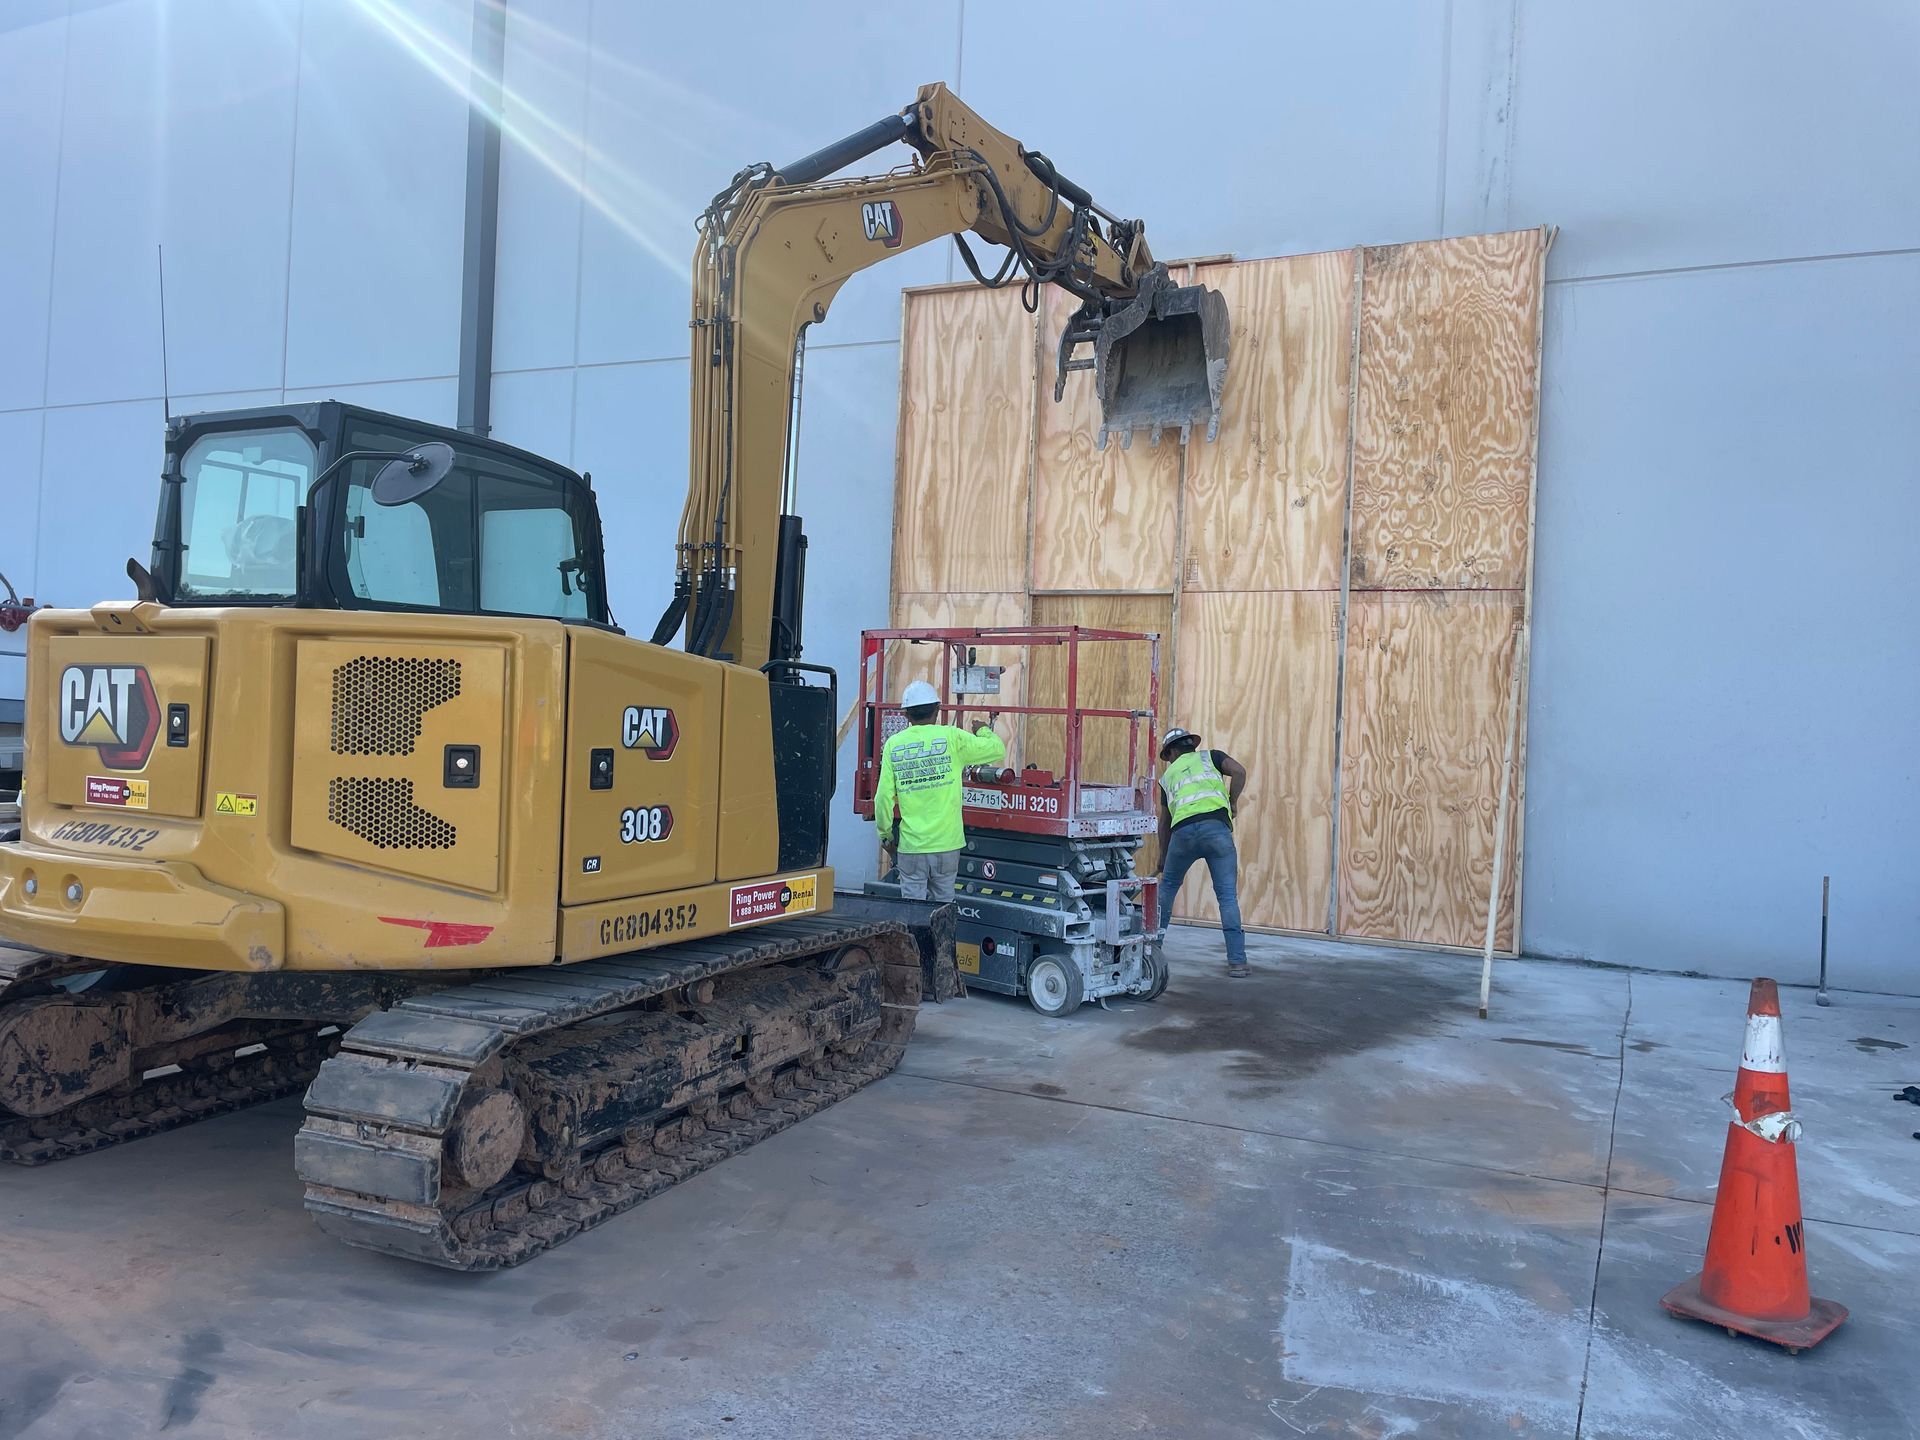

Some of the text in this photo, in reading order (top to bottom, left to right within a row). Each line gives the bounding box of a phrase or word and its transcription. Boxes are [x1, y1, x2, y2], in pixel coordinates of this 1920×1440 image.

[862, 202, 893, 240] CAT
[61, 667, 136, 744] CAT
[623, 707, 667, 748] CAT
[891, 737, 948, 762] CCLD
[102, 783, 120, 792] Power
[131, 790, 147, 798] Rental
[1030, 796, 1058, 814] 3219
[621, 807, 662, 842] 308
[51, 820, 160, 852] GG804352
[586, 859, 598, 870] CR
[736, 890, 776, 905] Ring Power
[780, 888, 814, 902] CAT Rental
[736, 908, 740, 917] 1
[600, 903, 697, 946] GG804352
